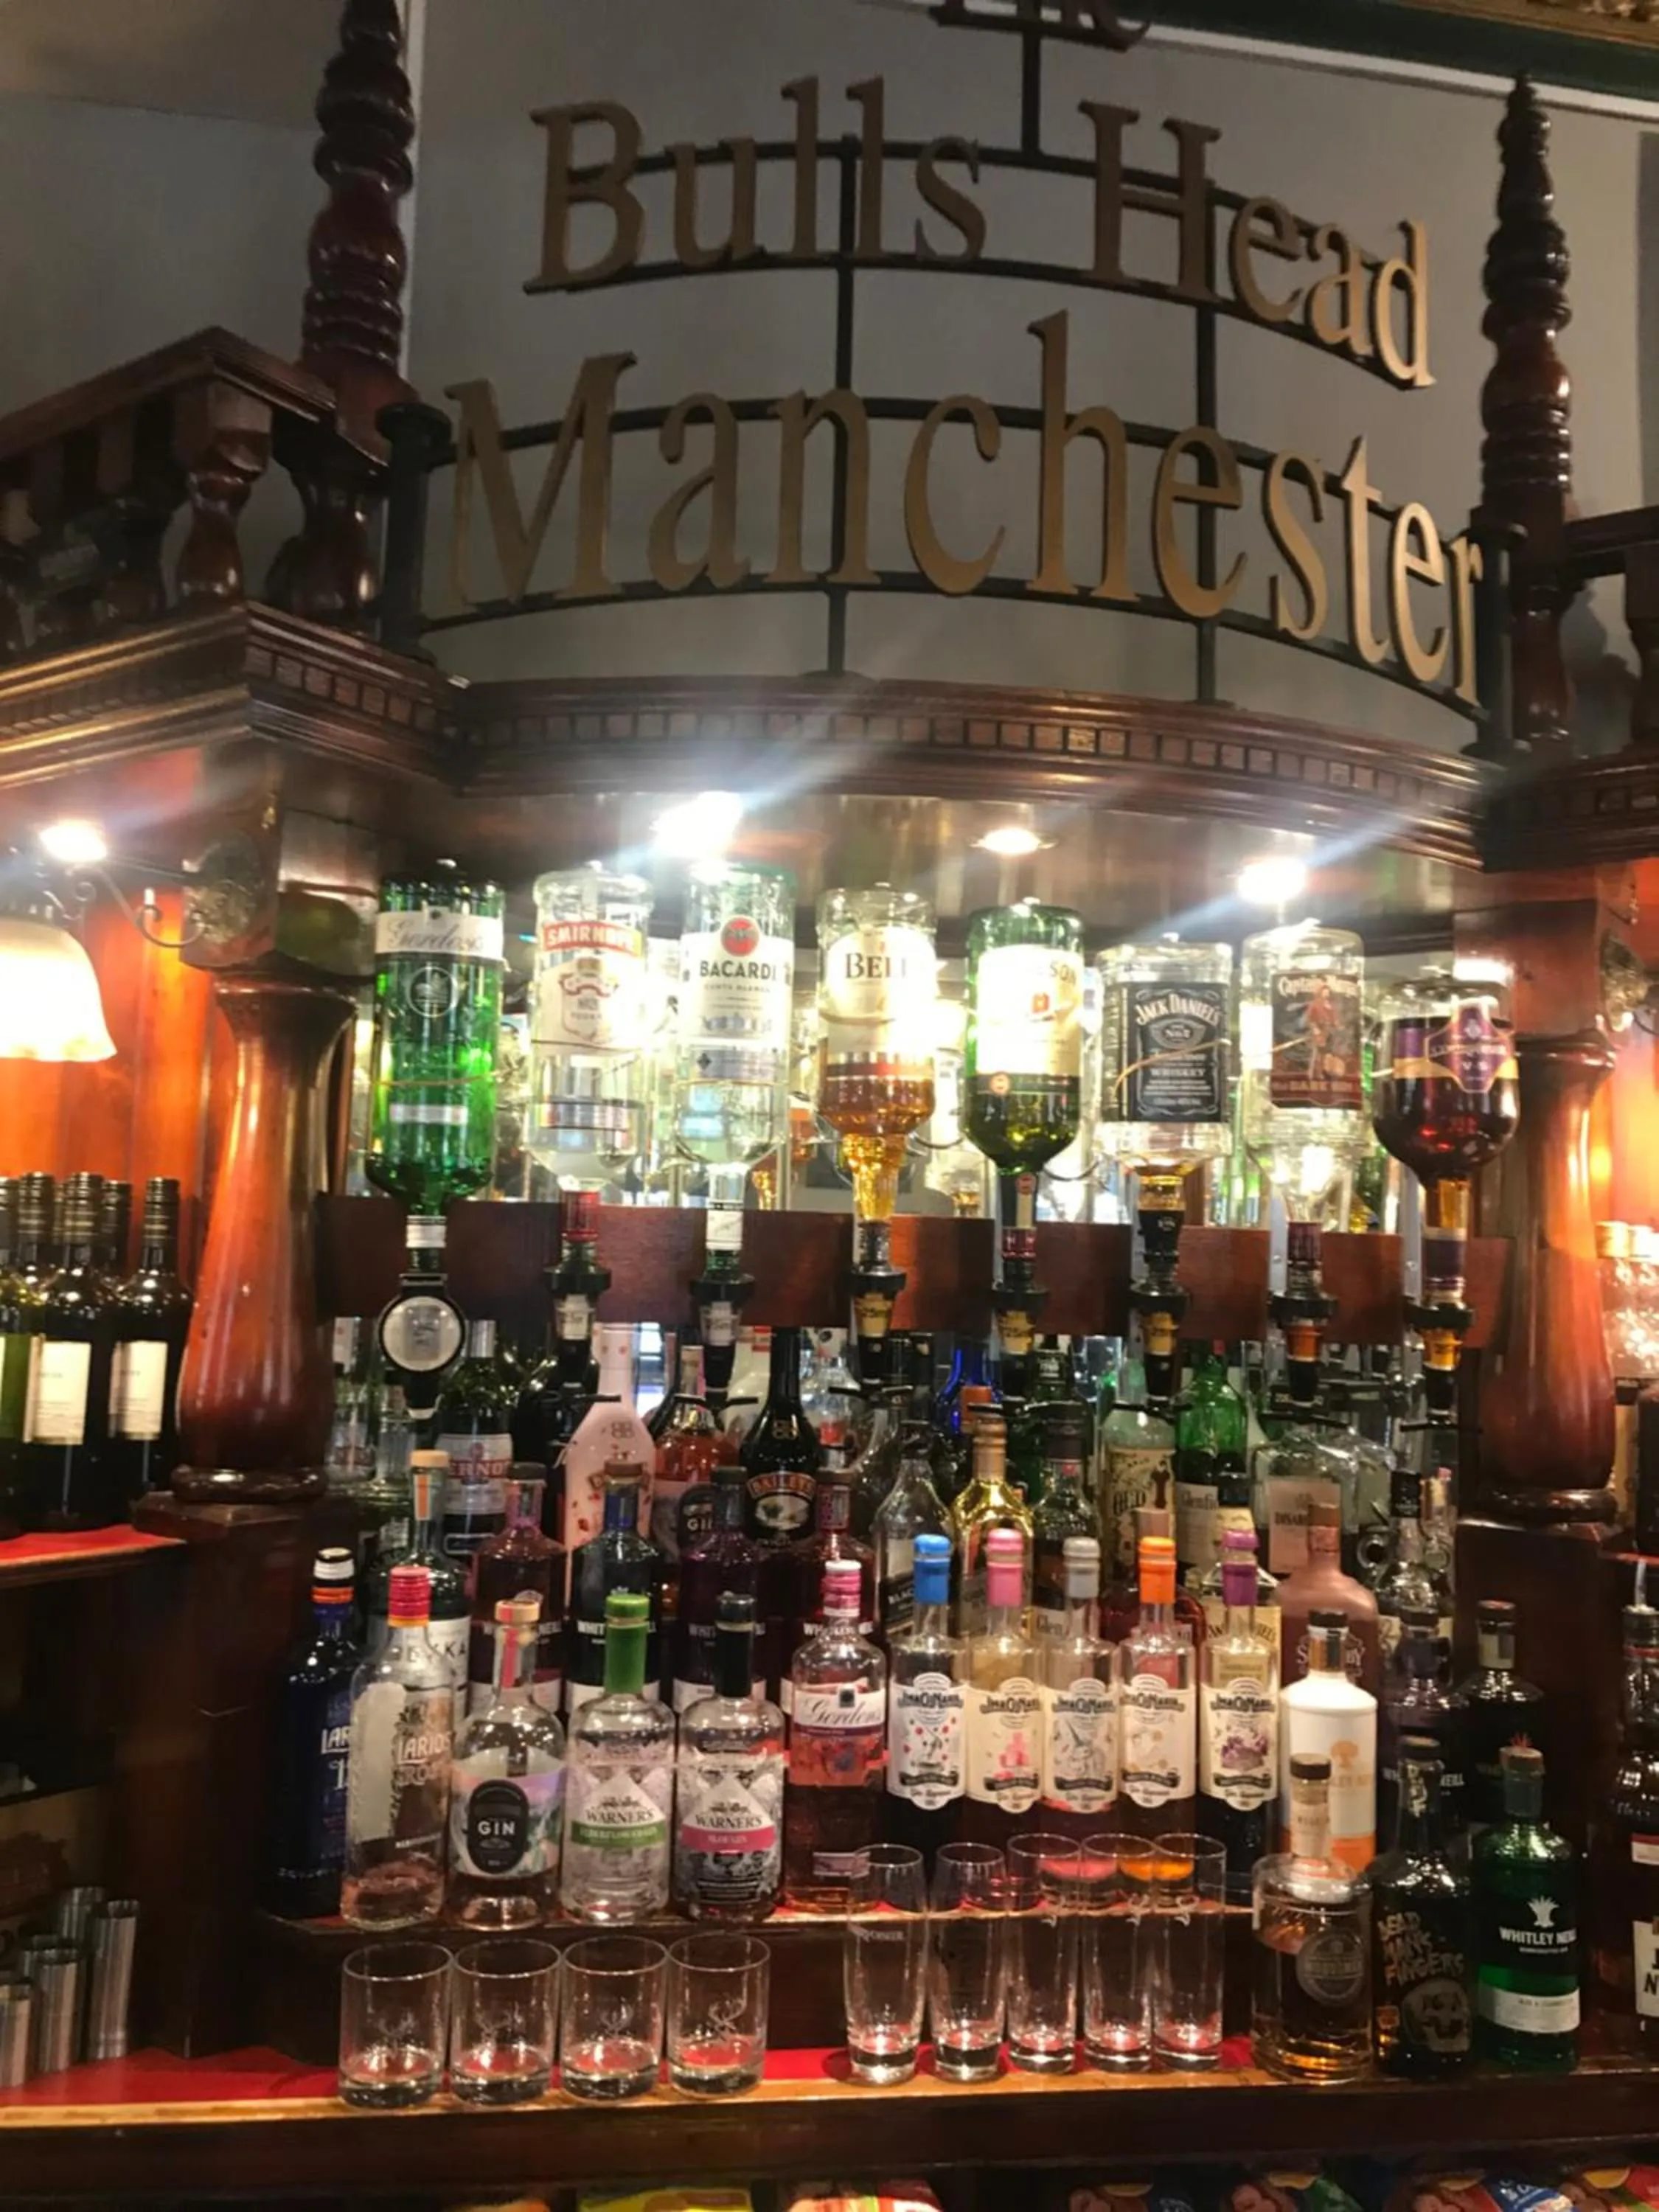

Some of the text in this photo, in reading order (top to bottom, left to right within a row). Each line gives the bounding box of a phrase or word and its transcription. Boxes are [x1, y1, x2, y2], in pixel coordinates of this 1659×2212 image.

[523, 74, 1436, 390] Bulls Head
[443, 308, 1483, 709] Manchester
[547, 923, 639, 953] SMIRN
[700, 960, 777, 981] BACARDI
[1135, 993, 1221, 1026] JACK DANIEL'S
[754, 1475, 813, 1493] BAILEYS
[1274, 1512, 1310, 1526] DISAR
[888, 1589, 914, 1605] BLAC
[577, 1620, 605, 1635] WHIT
[689, 1624, 716, 1638] WHIT
[321, 1725, 350, 1755] LAR
[398, 1732, 451, 1764] LARIOS
[478, 1820, 515, 1835] GIN
[1498, 1926, 1554, 1945] WHITLEY
